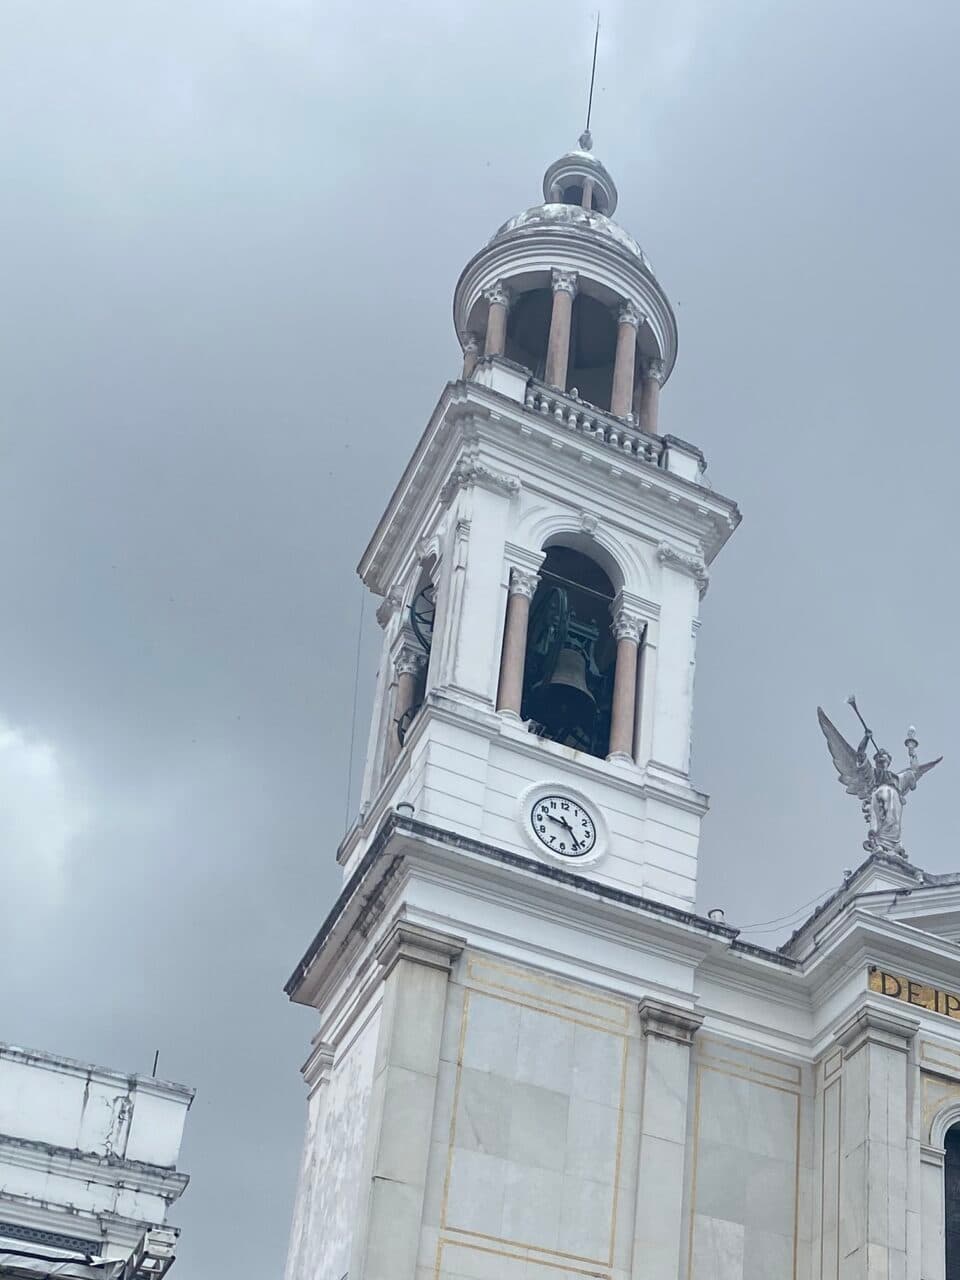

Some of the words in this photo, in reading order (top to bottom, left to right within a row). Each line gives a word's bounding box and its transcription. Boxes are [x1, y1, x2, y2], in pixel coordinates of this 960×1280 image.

[541, 805, 549, 814] 10
[561, 803, 570, 811] 12
[582, 819, 588, 827] 2
